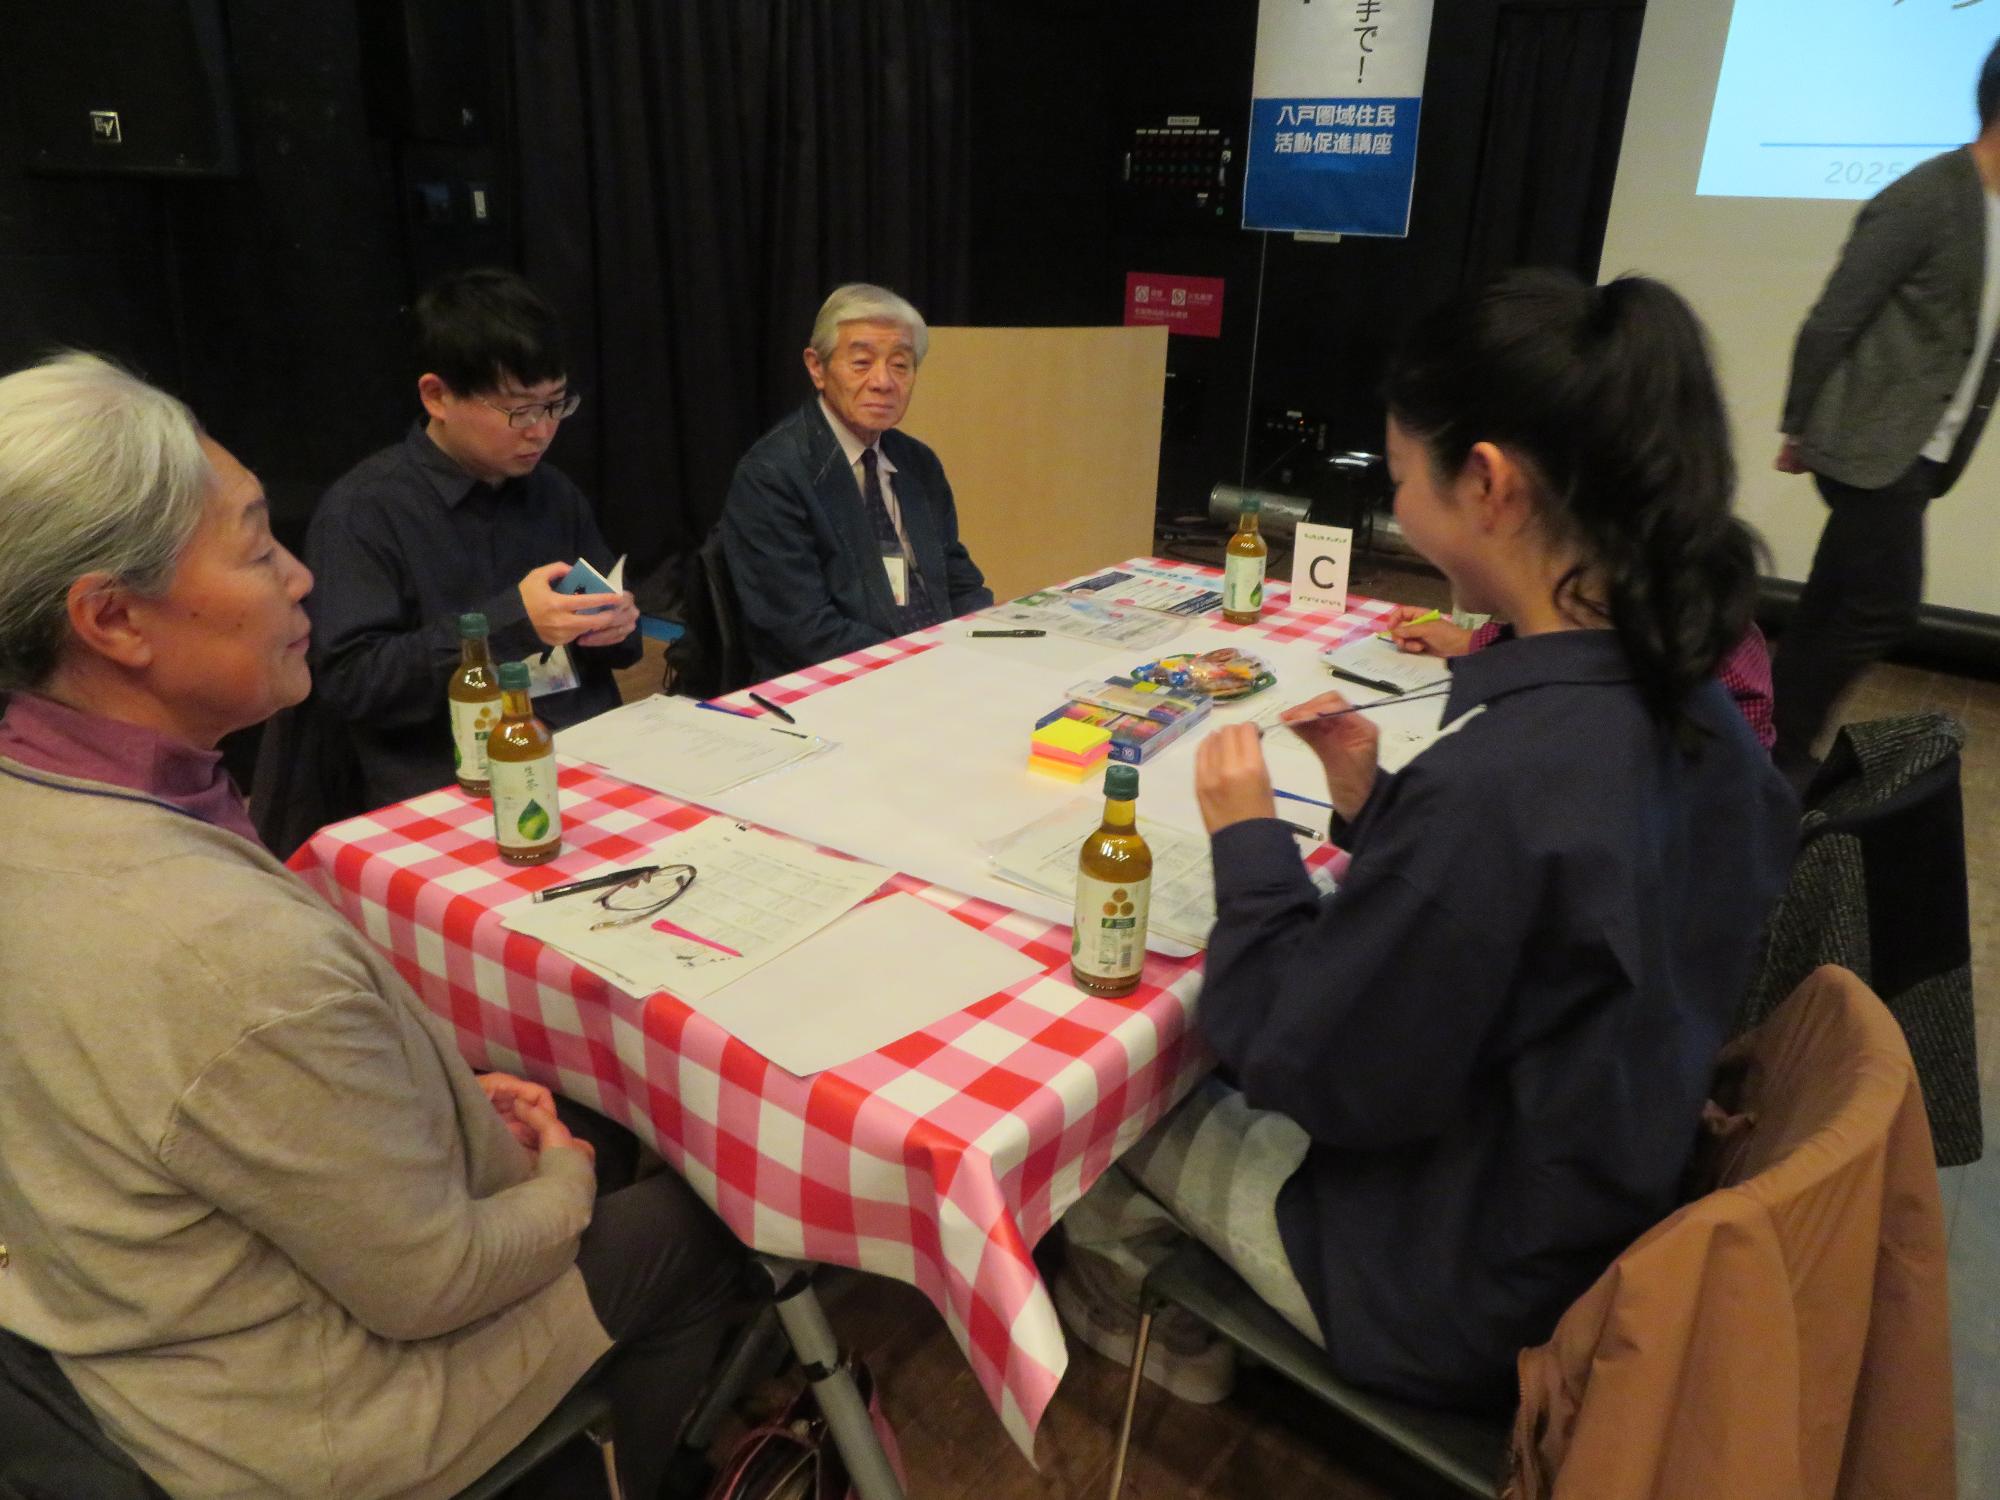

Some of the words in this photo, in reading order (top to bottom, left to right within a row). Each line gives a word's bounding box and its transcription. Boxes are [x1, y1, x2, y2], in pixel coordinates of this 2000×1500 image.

[1274, 132, 1393, 155] 活動促進講座
[1309, 555, 1336, 589] C
